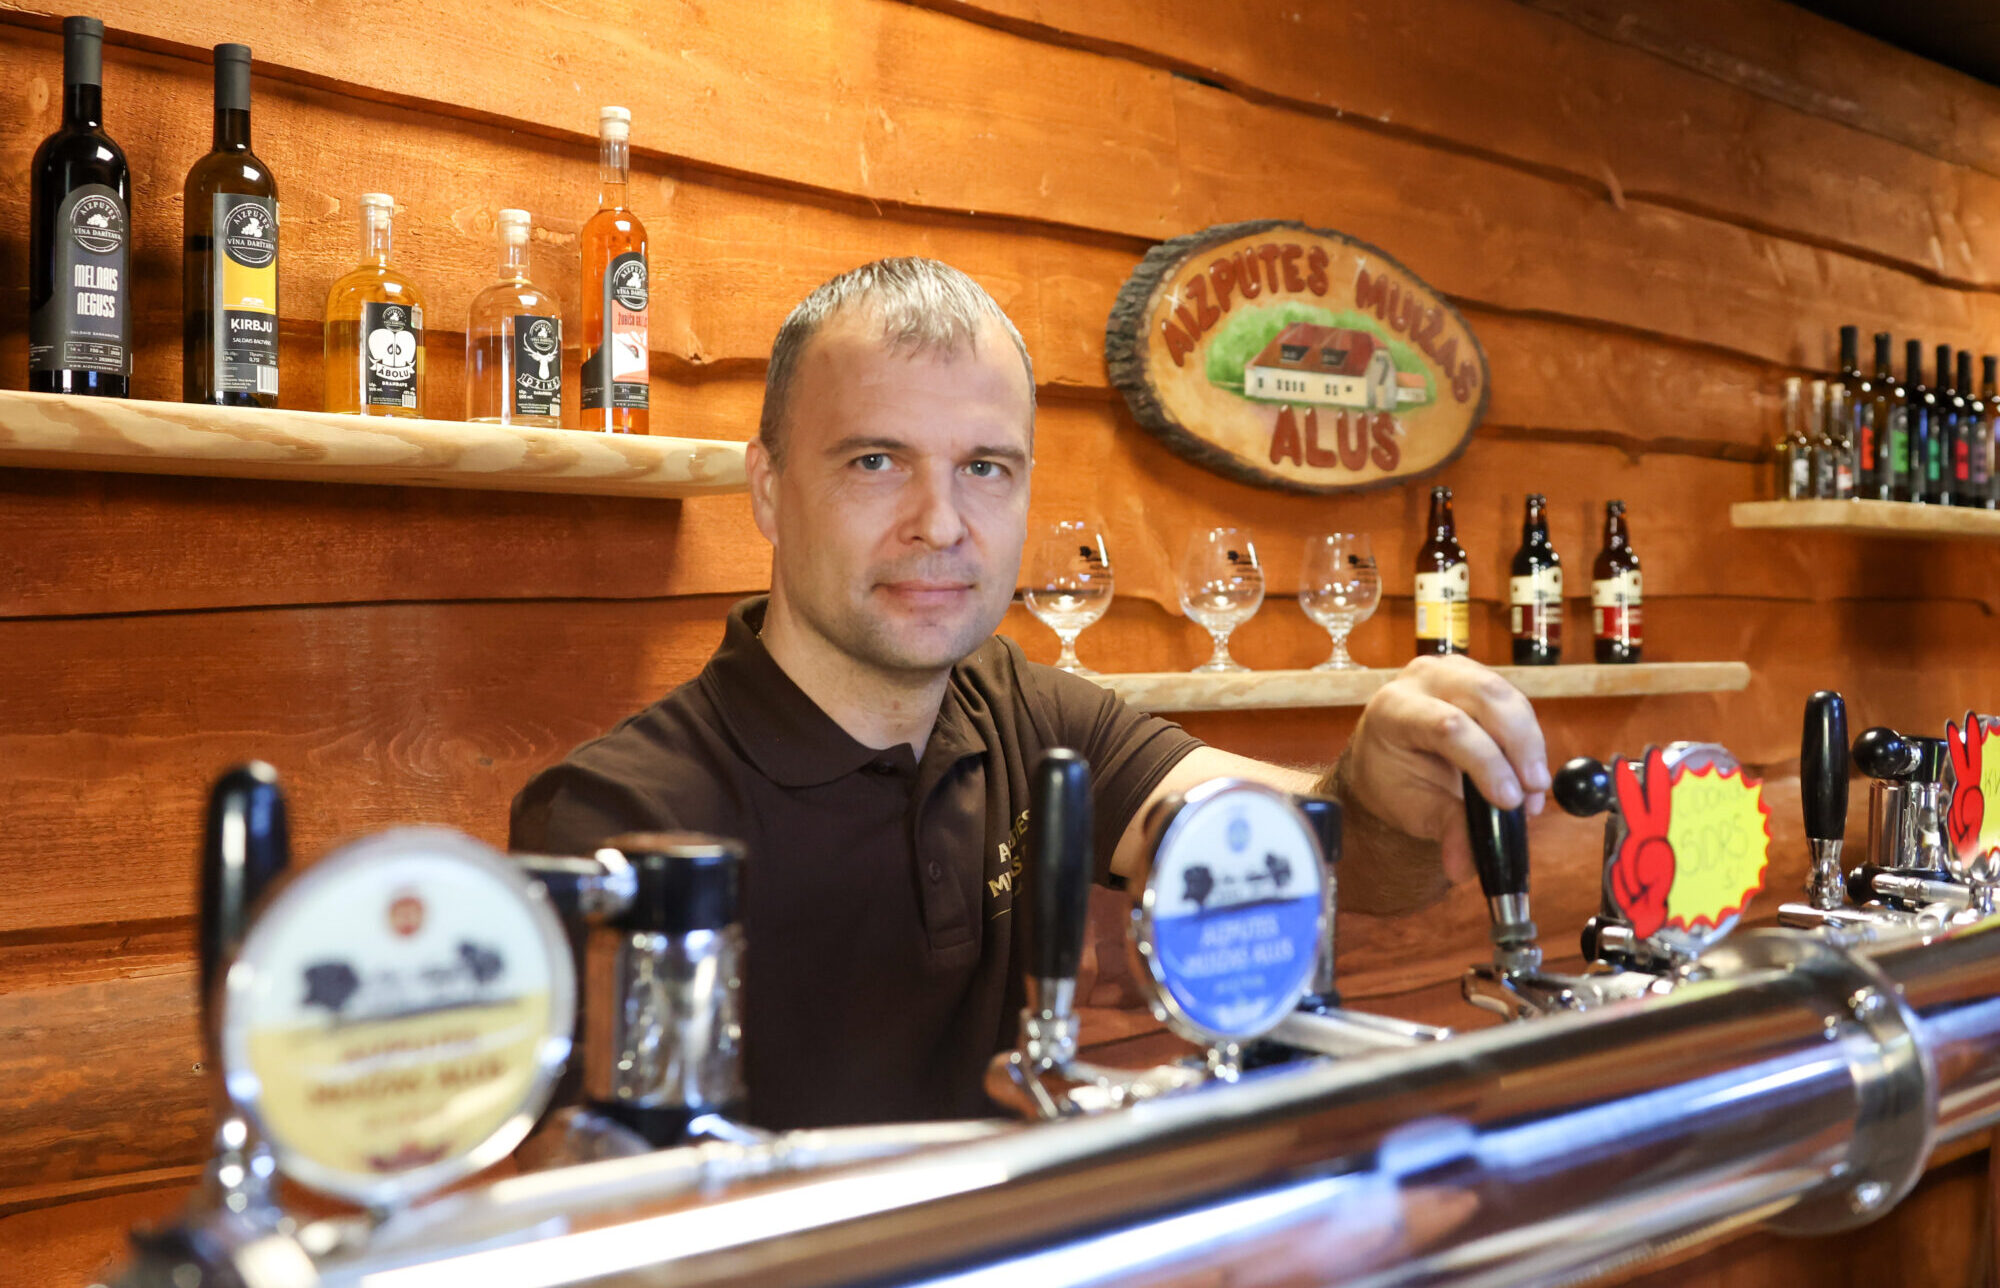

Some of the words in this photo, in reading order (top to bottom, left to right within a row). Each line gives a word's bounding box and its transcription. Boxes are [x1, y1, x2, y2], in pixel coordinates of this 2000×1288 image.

[79, 201, 117, 220] AIZPUTES
[232, 210, 270, 229] AIZPUTES
[227, 238, 246, 246] VĪNA
[1161, 243, 1329, 368] AIZPUTES
[230, 318, 273, 333] ĶIRBJU
[1269, 403, 1401, 472] ALUS
